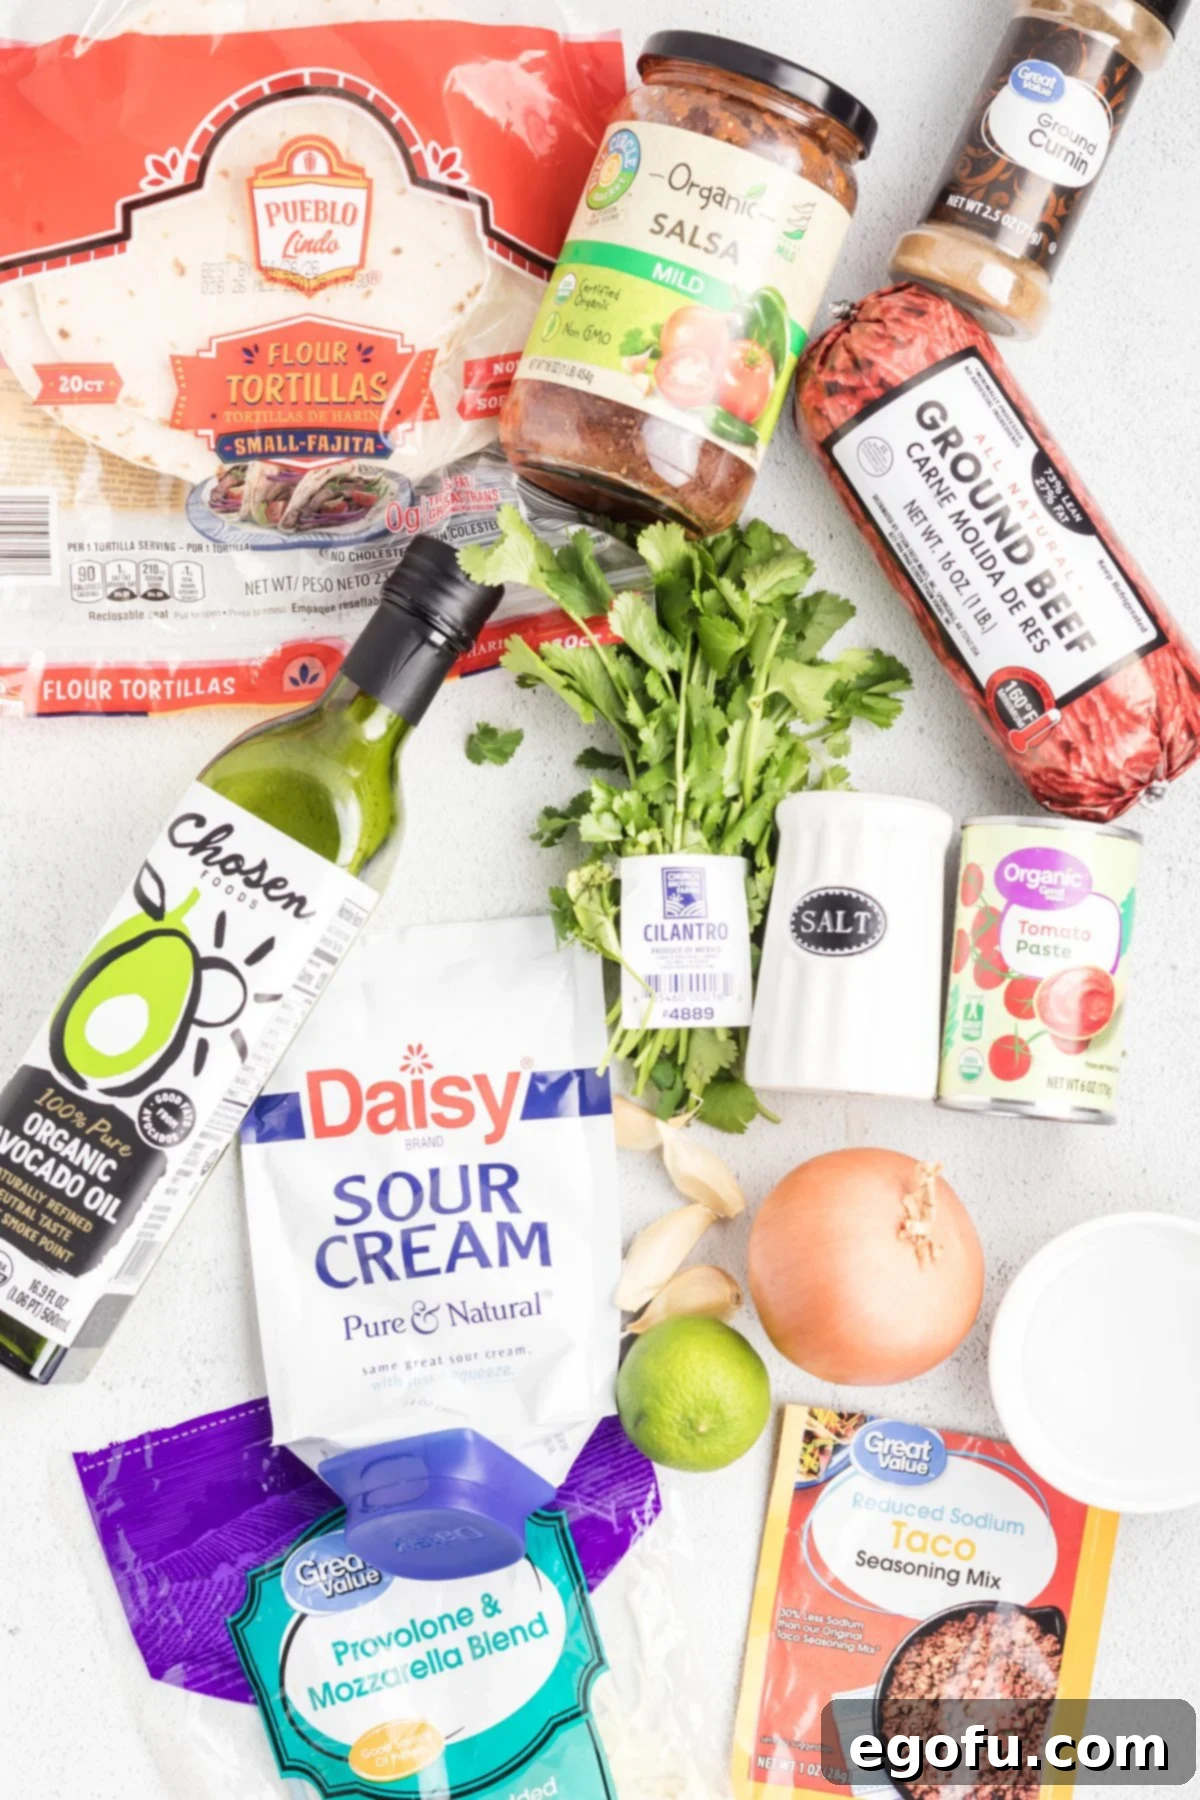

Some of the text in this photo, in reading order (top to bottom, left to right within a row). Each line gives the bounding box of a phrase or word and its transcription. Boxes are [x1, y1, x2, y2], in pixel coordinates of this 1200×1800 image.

[1017, 65, 1056, 90] Great
[1021, 79, 1053, 98] Value
[1036, 112, 1098, 157] Ground
[1028, 127, 1089, 176] Cumin
[667, 161, 758, 219] Organic
[264, 198, 358, 229] PUEBLO
[946, 193, 966, 209] NET
[965, 197, 984, 216] WT
[982, 204, 1001, 223] 2.5
[281, 228, 340, 259] Lindo
[648, 212, 741, 266] SALSA
[579, 278, 621, 302] Certified
[651, 261, 705, 295] MILD
[574, 294, 611, 311] Organic
[562, 321, 612, 345] Non GMO
[267, 340, 349, 366] FLOUR
[492, 360, 518, 376] NO
[58, 375, 105, 393] 20CT
[226, 371, 390, 406] TORTILLAS
[224, 410, 304, 424] TORTILLAS
[305, 409, 325, 423] DE
[233, 434, 377, 457] SMALL-FAJITA
[973, 431, 1003, 473] ALL
[1034, 477, 1070, 526] 27% FAT
[1043, 466, 1084, 525] 73% LEAN
[915, 398, 1036, 567] GROUND
[1024, 565, 1098, 654] BEEF
[67, 541, 85, 553] PER
[94, 541, 135, 553] TORTILLA
[138, 541, 176, 553] SERVING
[330, 549, 346, 563] NO
[902, 498, 926, 528] NET
[919, 525, 943, 557] WT.
[937, 549, 955, 576] 16
[947, 568, 970, 598] OZ.
[906, 441, 957, 511] CARNE
[949, 508, 1012, 590] MOLIDA
[1000, 586, 1027, 616] DE
[1019, 614, 1051, 655] RES
[77, 565, 96, 583] 90
[245, 574, 370, 596] NET WT/ PESO NETO
[1097, 557, 1149, 634] Keep Refrigerated
[88, 602, 336, 622] Reclosable Empaque
[42, 676, 236, 701] FLOUR TORTILLAS
[996, 687, 1026, 730] MINIMUM
[167, 812, 316, 921] Chosen
[1003, 862, 1083, 890] Organic
[199, 869, 259, 912] FOODS
[643, 922, 729, 943] CILANTRO
[800, 909, 872, 935] SALT
[1018, 918, 1092, 943] Tomato
[1015, 939, 1073, 960] Paste
[662, 1007, 715, 1021] #4889
[154, 1092, 182, 1105] GOOD
[306, 1050, 522, 1146] Daisy
[1046, 1075, 1067, 1088] NET
[1067, 1077, 1081, 1091] WT
[34, 1087, 133, 1159] 100% Pure
[142, 1107, 179, 1143] AVOCADOS
[156, 1107, 179, 1129] FROM
[23, 1111, 118, 1183] ORGANIC
[404, 1135, 444, 1150] BRAND
[83, 1185, 123, 1225] OIL
[332, 1162, 522, 1227] SOUR
[38, 1214, 73, 1243] TASTE
[46, 1194, 93, 1235] REFINED
[1, 1213, 74, 1264] SMOKE POINT
[314, 1220, 552, 1290] CREAM
[28, 1278, 69, 1312] 16.9 FL OZ
[342, 1292, 542, 1341] Pure & Natural
[362, 1345, 532, 1376] same great sour cream.
[863, 1430, 932, 1462] Great
[877, 1453, 929, 1476] Value
[852, 1490, 1025, 1536] Reduced Sodium
[891, 1519, 977, 1563] Taco
[295, 1553, 371, 1586] Grea
[319, 1567, 381, 1598] Value
[854, 1550, 1002, 1590] Seasoning Mix
[331, 1592, 503, 1667] Provolone &
[777, 1619, 863, 1641] than our Original
[803, 1610, 824, 1623] Less
[826, 1615, 864, 1629] Sodium
[776, 1630, 800, 1642] Taco
[803, 1634, 855, 1653] Seasoning
[306, 1611, 550, 1712] Mozzarella Blend
[756, 1756, 776, 1770] NET
[799, 1763, 804, 1773] 1
[807, 1763, 822, 1777] OZ
